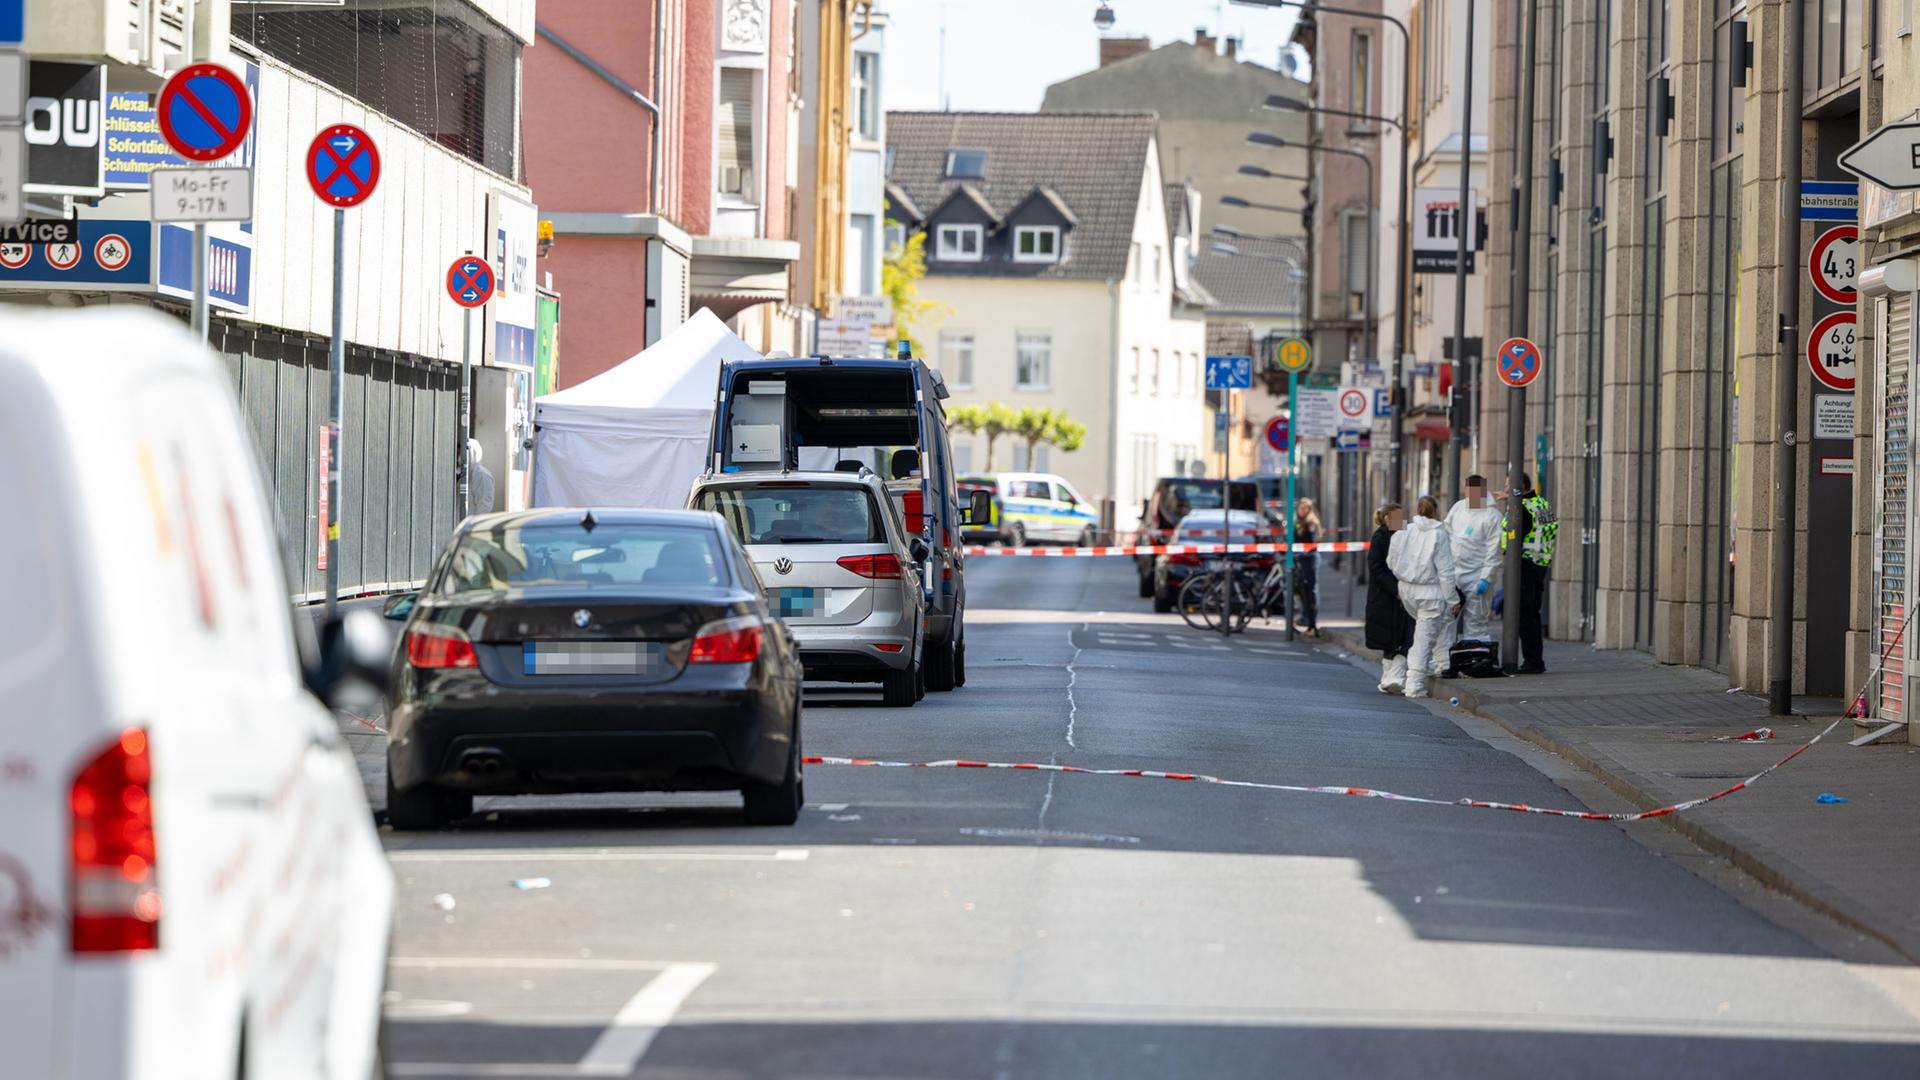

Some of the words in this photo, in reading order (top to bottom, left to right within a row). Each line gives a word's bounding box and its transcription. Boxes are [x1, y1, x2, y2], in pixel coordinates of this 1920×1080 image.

[172, 176, 229, 192] Mo-Fr
[0, 218, 68, 241] rvice
[1823, 250, 1855, 279] 4,3
[1831, 328, 1855, 345] 6,6
[1344, 396, 1361, 409] 30
